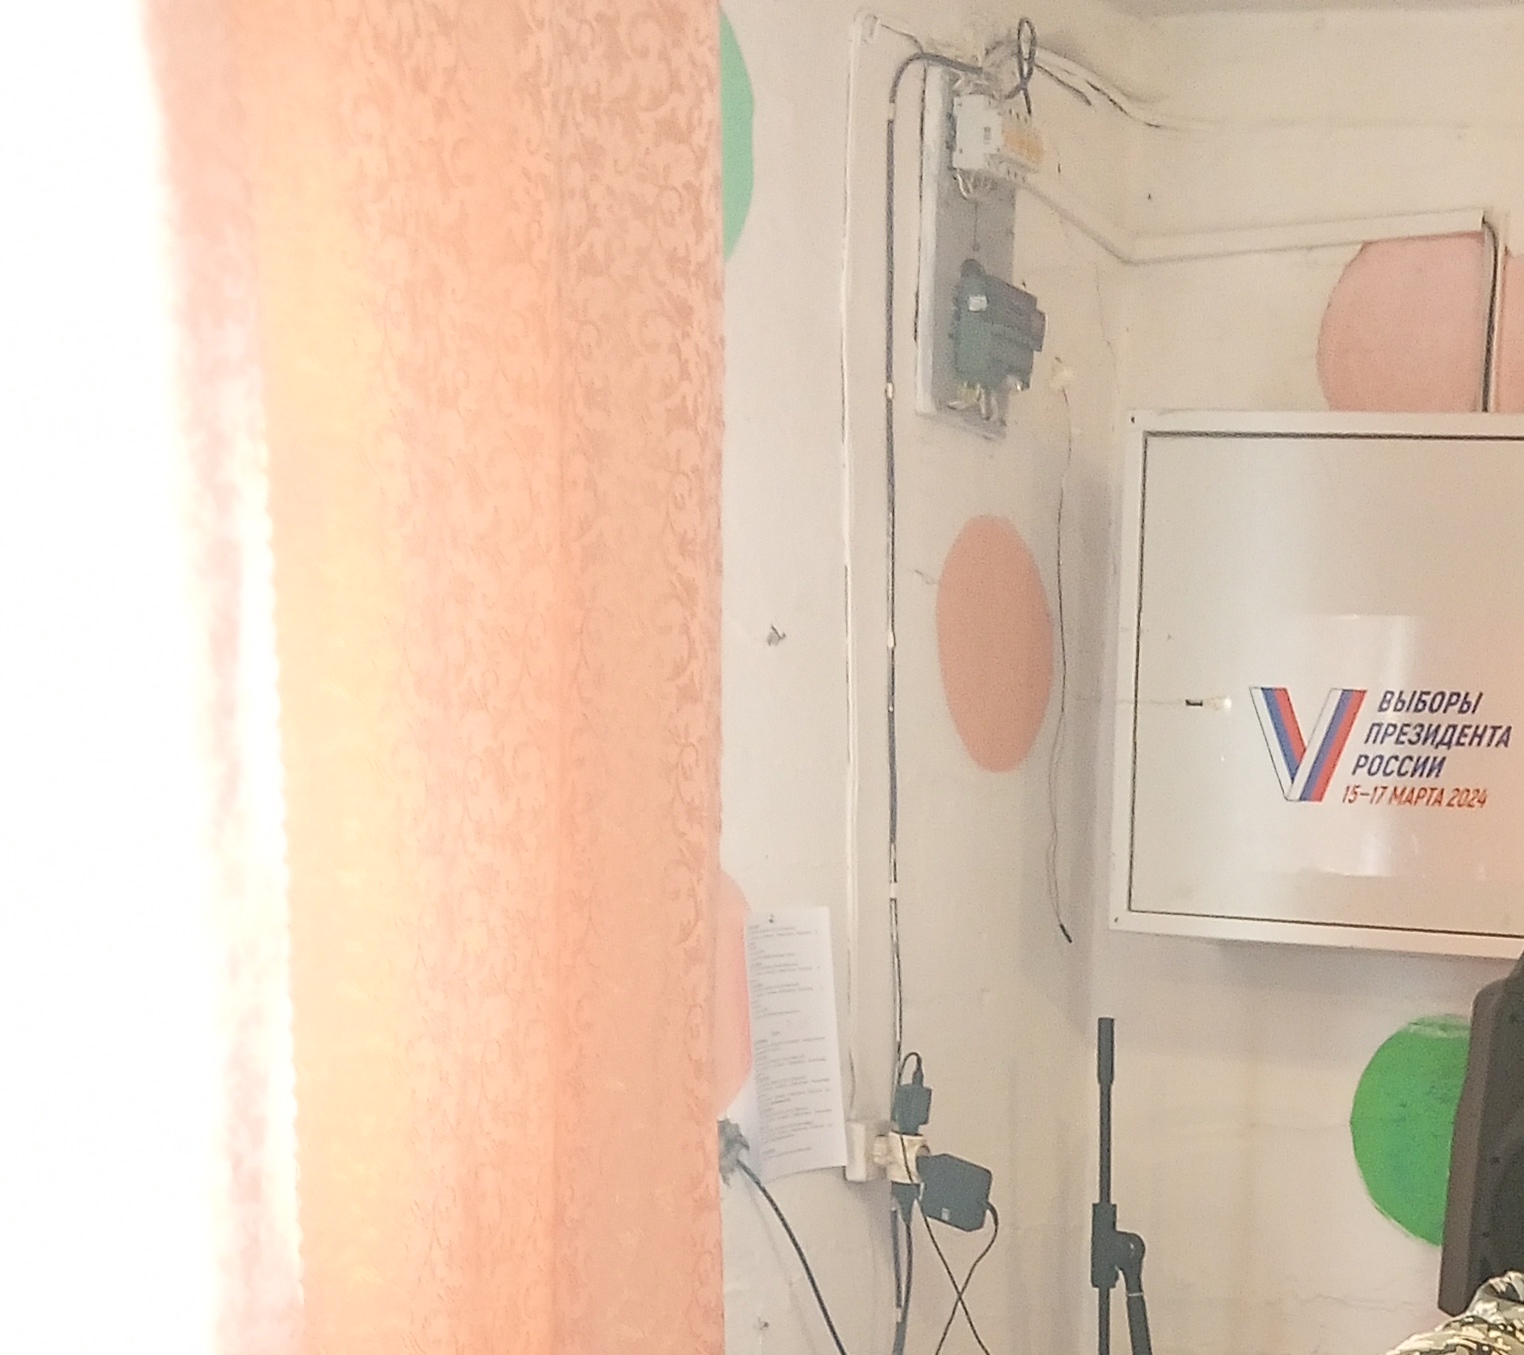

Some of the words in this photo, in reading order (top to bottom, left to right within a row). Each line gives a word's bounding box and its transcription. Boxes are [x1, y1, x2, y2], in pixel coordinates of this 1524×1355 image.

[1377, 690, 1483, 714] ВЫБОРЫ
[1364, 722, 1512, 750] ПРЕЗИДЕНТА
[1352, 754, 1446, 778] РОССИИ
[1342, 785, 1387, 804] 15–17
[1388, 786, 1445, 806] МАРТА
[1446, 788, 1488, 809] 2024
